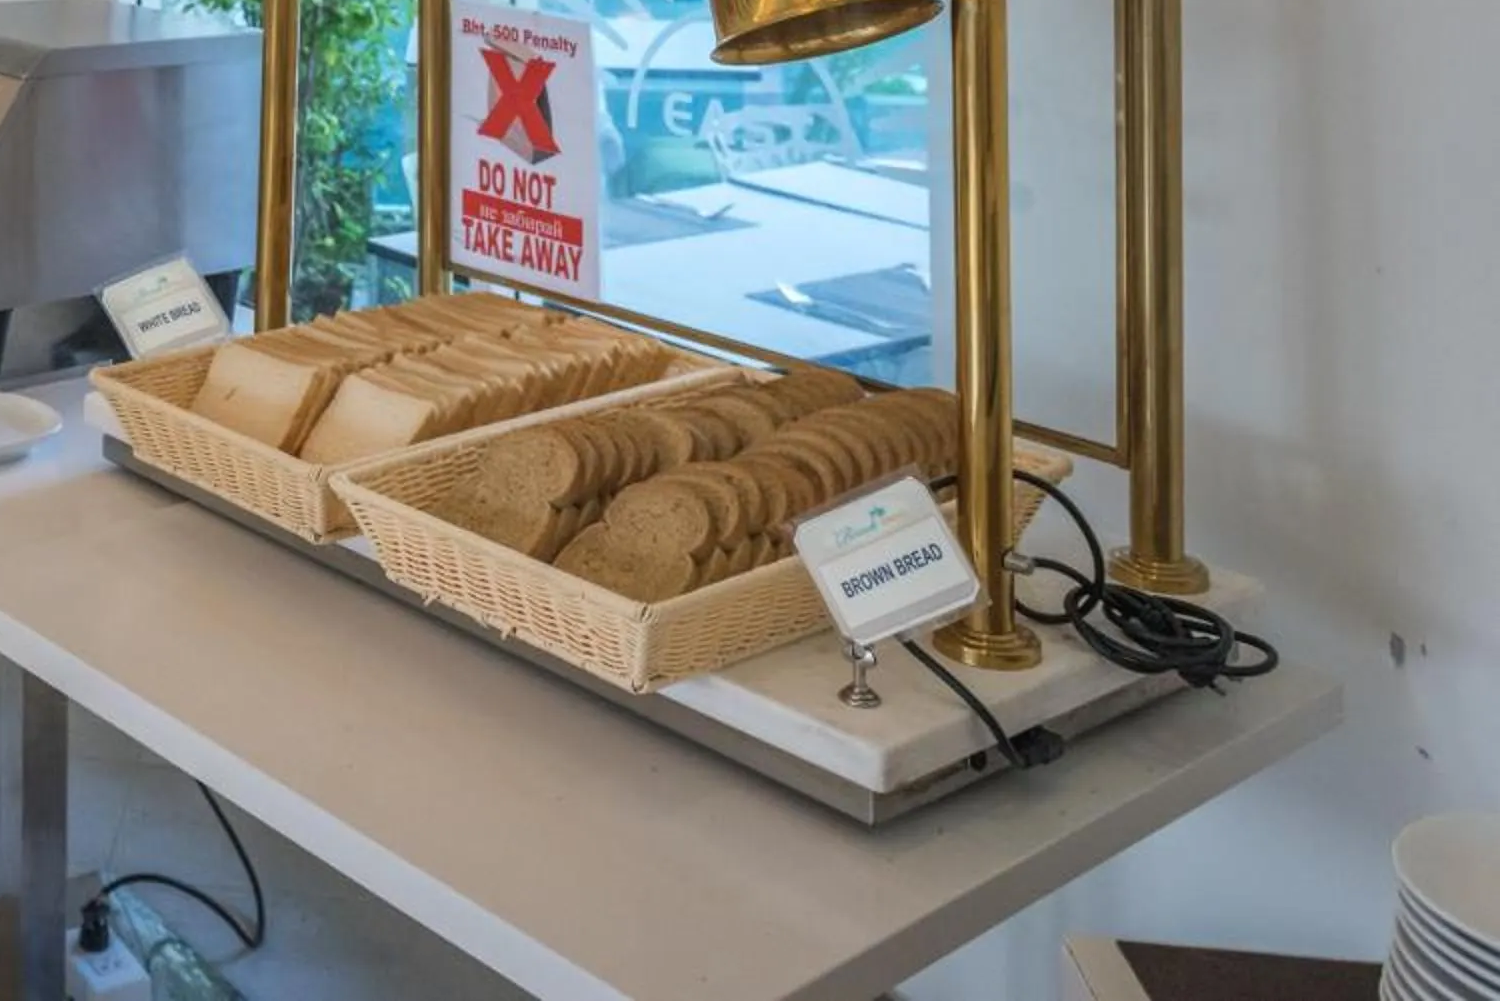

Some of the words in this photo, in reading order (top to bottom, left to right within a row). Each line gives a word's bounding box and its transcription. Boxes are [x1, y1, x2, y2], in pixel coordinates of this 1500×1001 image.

[493, 24, 519, 43] 500
[523, 29, 578, 58] Penalty
[479, 159, 505, 194] DO
[514, 168, 557, 209] NOT
[462, 218, 515, 264] TAKE
[521, 235, 584, 283] AWAY
[138, 313, 169, 332] WHITE
[170, 302, 201, 321] BREAD
[840, 563, 895, 599] BROWN
[894, 542, 943, 576] BREAD
